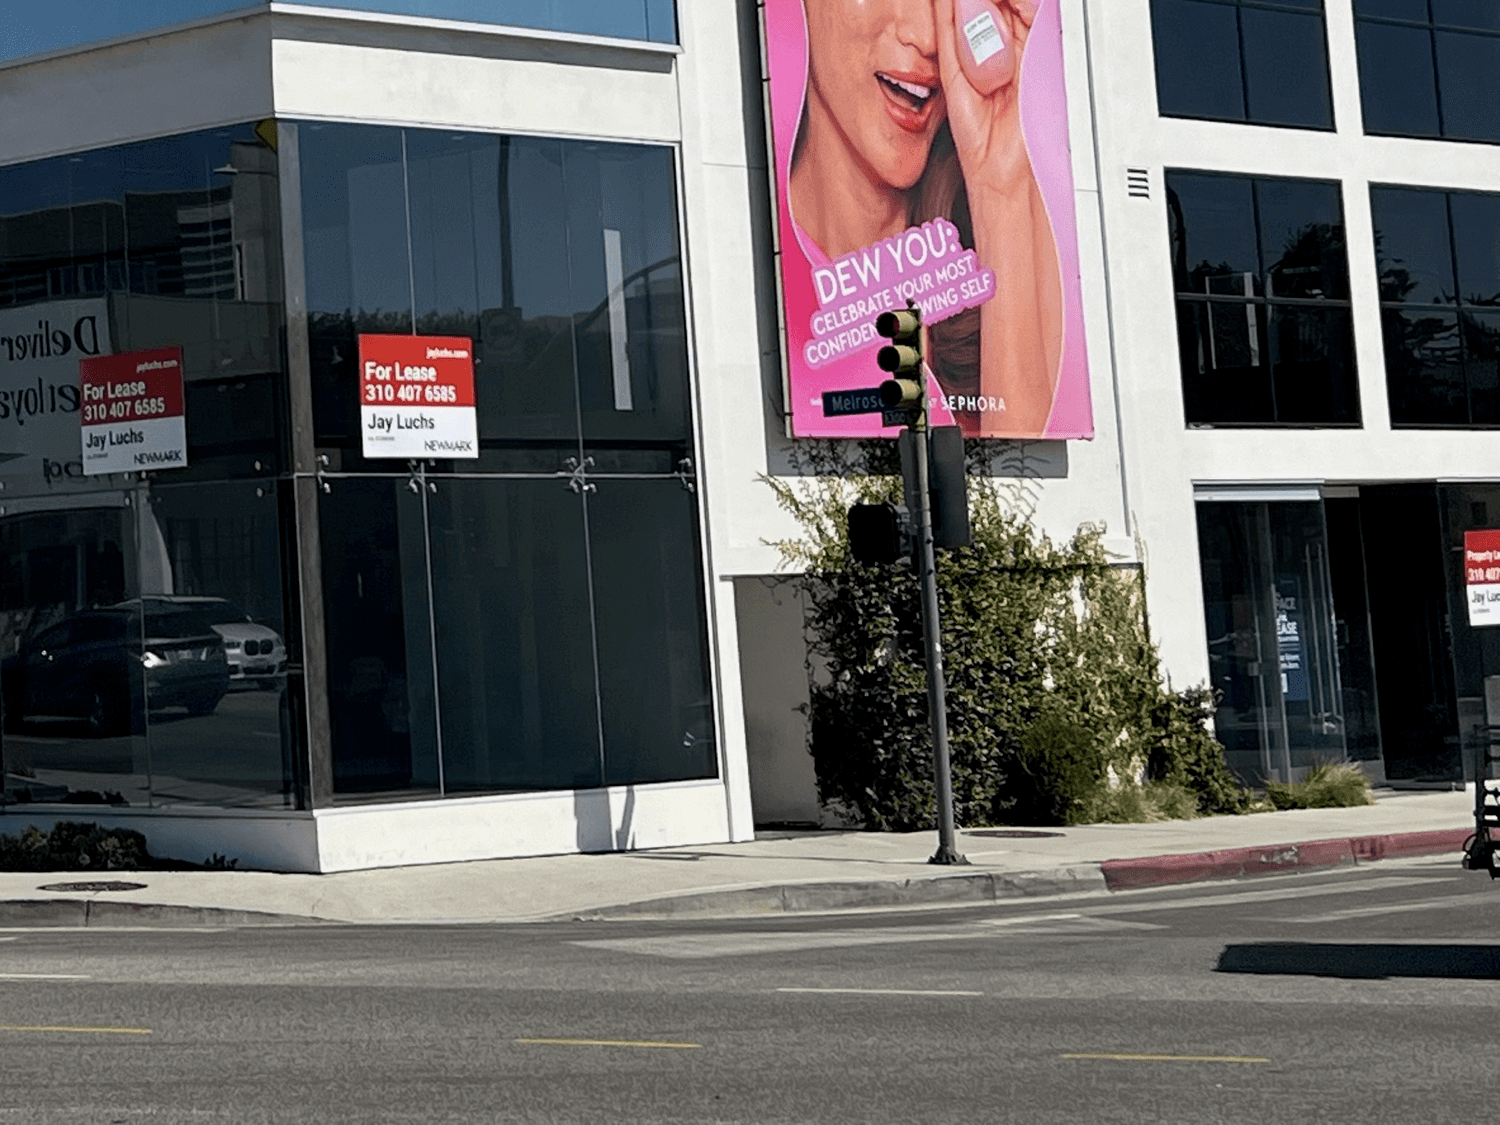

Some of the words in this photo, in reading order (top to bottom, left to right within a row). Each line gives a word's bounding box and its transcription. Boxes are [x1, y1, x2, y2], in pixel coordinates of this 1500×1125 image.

[815, 247, 880, 304] DEW
[886, 222, 957, 273] YOU:
[813, 289, 894, 335] CELEBRATE
[893, 273, 935, 300] YOUR
[934, 255, 974, 285] MOST
[806, 322, 877, 364] CONFIDEN
[960, 273, 991, 299] SELF
[364, 361, 392, 381] For
[395, 361, 437, 382] Lease
[83, 383, 105, 401] For
[107, 381, 146, 398] Lease
[364, 383, 394, 402] 310
[396, 383, 423, 402] 407
[424, 384, 457, 403] 6585
[84, 403, 107, 421] 310
[109, 401, 131, 417] 407
[134, 397, 165, 415] 6585
[940, 395, 1007, 412] SEPHORA
[367, 413, 393, 433] Jay
[397, 413, 436, 430] Luchs
[86, 432, 106, 451] Jay
[109, 427, 145, 446] Luchs
[424, 439, 472, 452] NEWMARK
[133, 449, 182, 465] NEWMARK
[1468, 567, 1485, 581] 310
[1472, 590, 1485, 606] Jay
